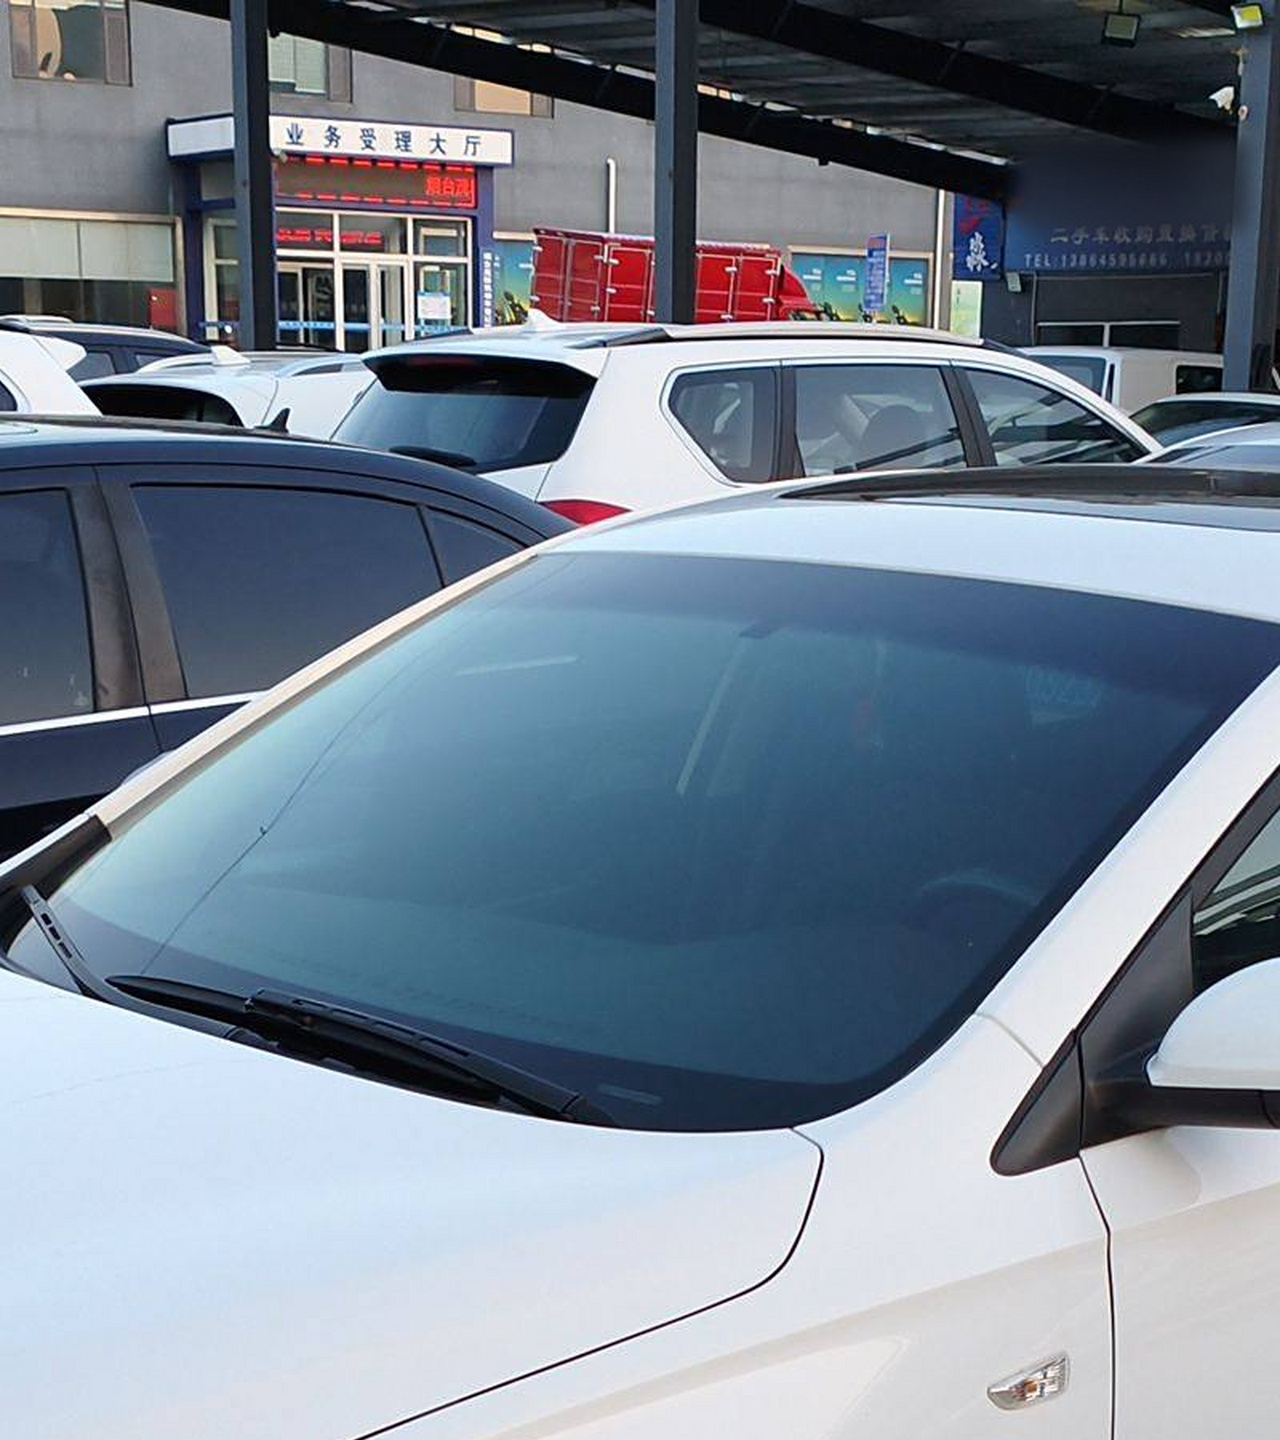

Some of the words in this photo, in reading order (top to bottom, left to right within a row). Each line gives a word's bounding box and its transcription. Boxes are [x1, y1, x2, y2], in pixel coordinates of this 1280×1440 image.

[285, 122, 482, 157] 业务受理大厅
